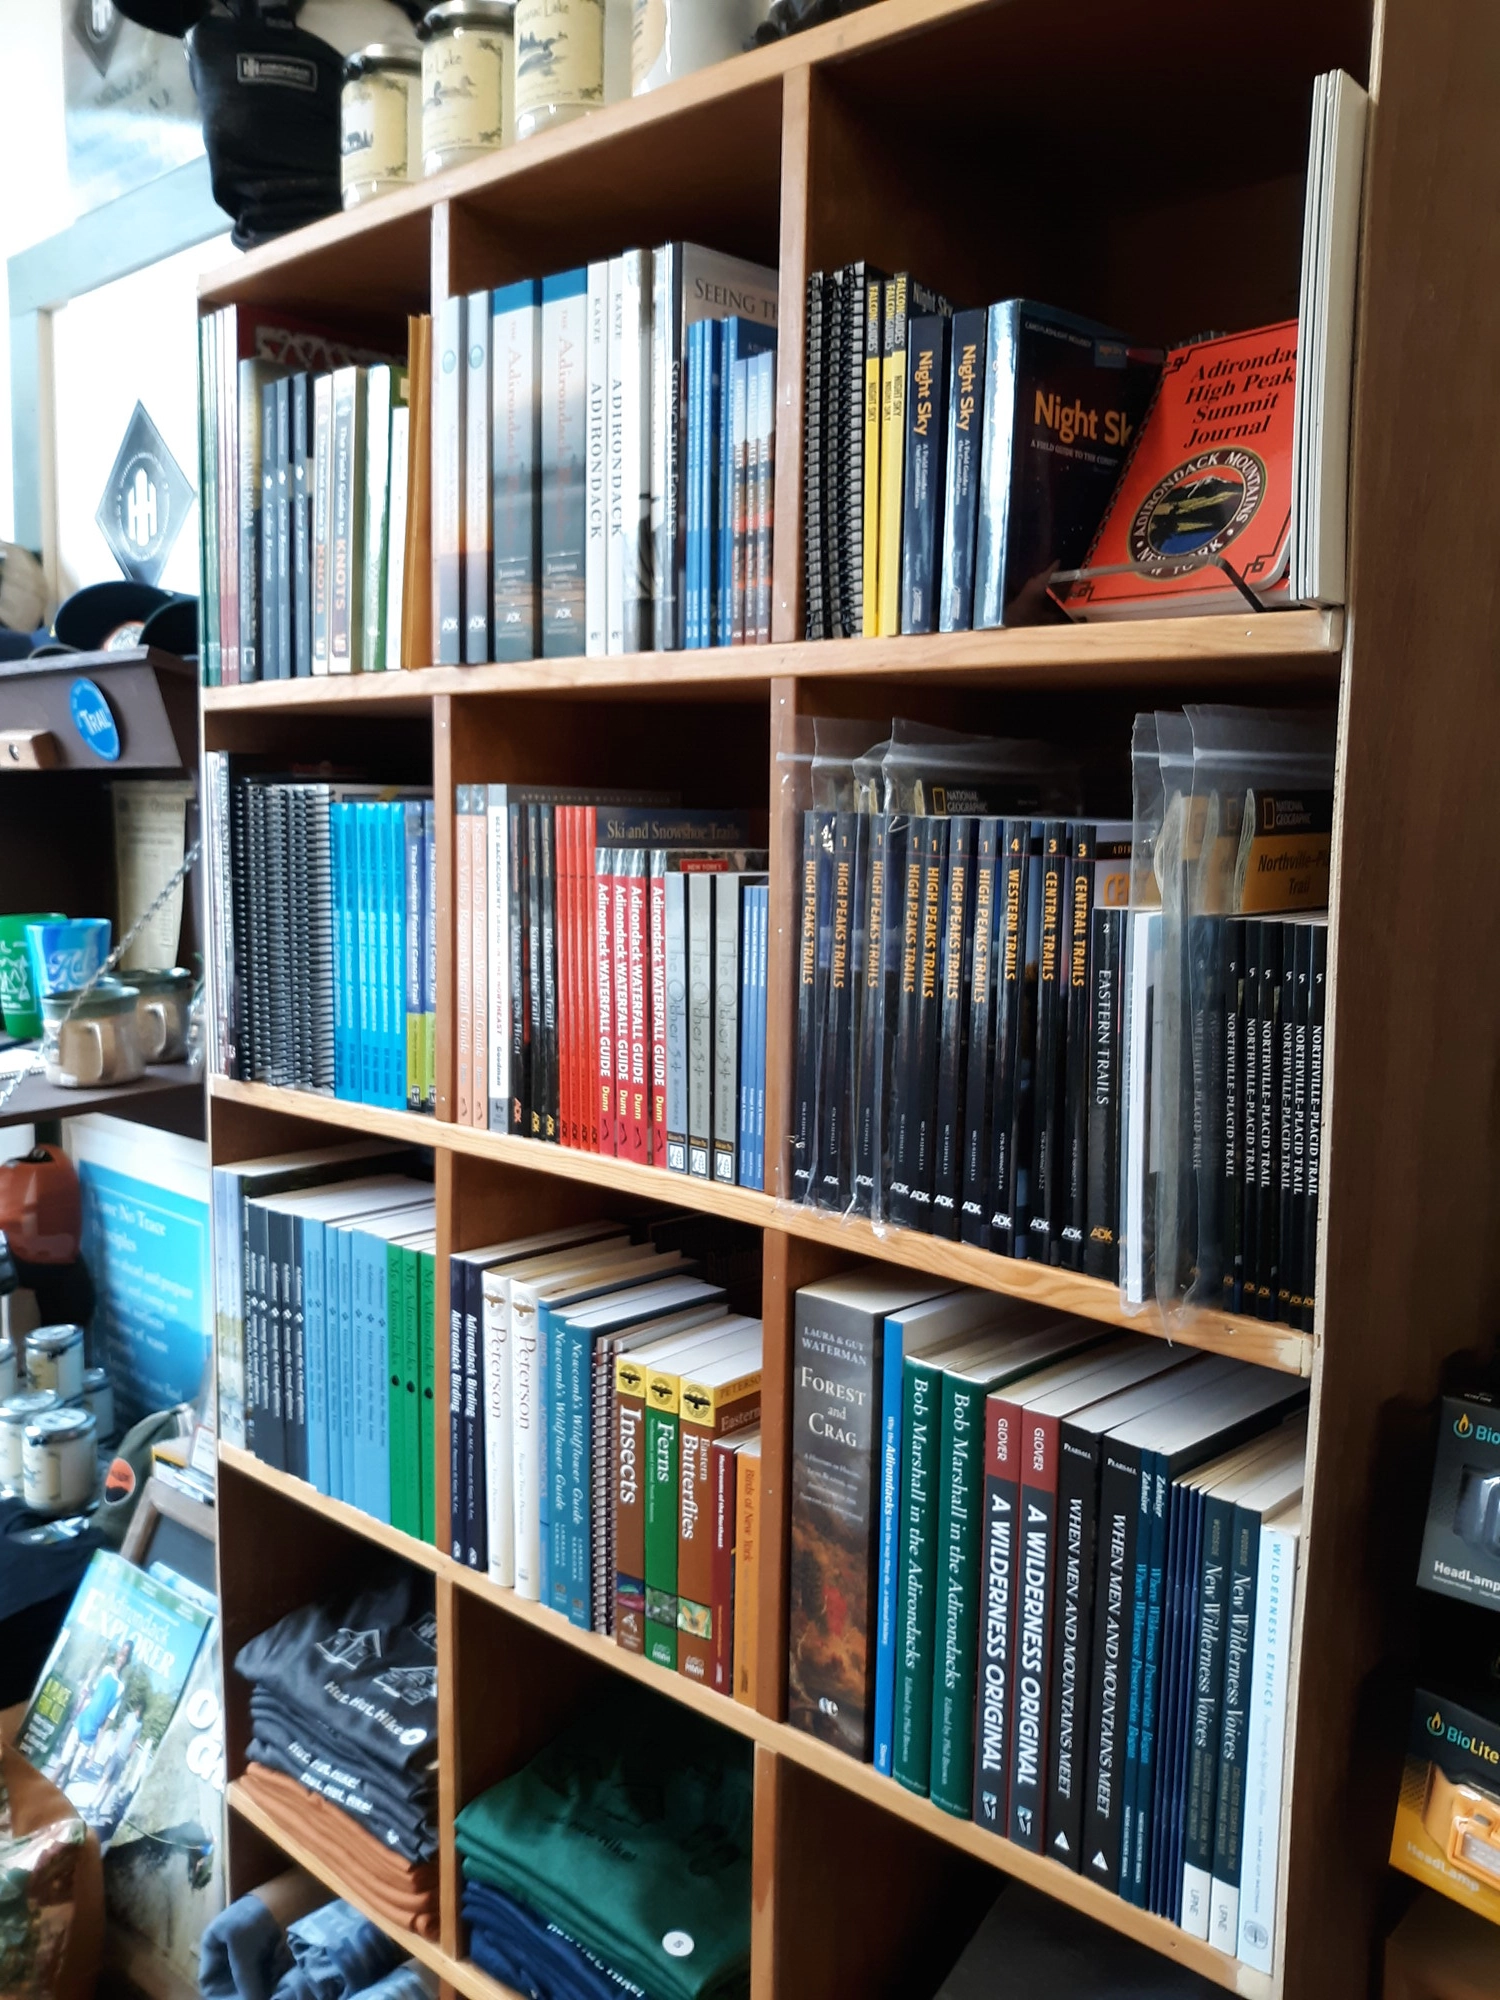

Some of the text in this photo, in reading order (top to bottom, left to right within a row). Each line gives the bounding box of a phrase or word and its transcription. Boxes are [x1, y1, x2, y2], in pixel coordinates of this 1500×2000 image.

[694, 277, 756, 315] SEEING
[913, 350, 934, 400] Night
[957, 344, 977, 395] Night
[1184, 366, 1295, 406] High Peak
[1190, 346, 1298, 384] Adirondac
[1192, 391, 1280, 425] Summit
[913, 400, 933, 437] Sky
[956, 396, 976, 432] Sky
[1033, 389, 1134, 448] Night Sk
[1182, 414, 1272, 449] Journal
[590, 382, 603, 538] ADIRONDACK
[611, 378, 623, 537] ADIRONDACK
[1133, 451, 1262, 537] ADIRONDACK MOUNTAINS
[606, 819, 627, 839] Ski
[626, 821, 648, 839] and
[802, 861, 816, 985] HIGH PEAKS TRAILS
[833, 862, 849, 989] HIGH PEAKS TRAILS
[867, 861, 883, 989] HIGH PEAKS TRAILS
[902, 864, 921, 993] HIGH PEAKS TRAILS
[922, 867, 939, 998] HIGH PEAKS TRAILS
[947, 867, 964, 1000] HIGH PEAKS TRAILS
[973, 869, 990, 1004] HIGH PEAKS TRAILS
[1003, 868, 1020, 981] WESTERN TRAILS
[1042, 871, 1058, 981] CENTRAL TRAILS
[1072, 876, 1088, 987] CENTRAL TRAILS
[598, 883, 611, 1112] Adirondack WATERFALL GUIDE Dunn
[614, 884, 628, 1115] Adirondack WATERFALL GUIDE Dunn
[631, 885, 644, 1120] Adirondack WATERFALL GUIDE Dunn
[653, 886, 665, 1122] Adirondack WATERFALL GUIDE Dunn
[1096, 969, 1112, 1106] EASTERN TRAILS
[1225, 1141, 1236, 1177] TRAIL
[1245, 1147, 1256, 1184] TRAIL
[1260, 1151, 1271, 1187] TRAIL
[1281, 1153, 1291, 1190] TRAIL
[1293, 1157, 1304, 1195] TRAIL
[1307, 1159, 1319, 1196] TRAIL
[449, 1309, 462, 1413] Adirondack Birding
[464, 1313, 478, 1418] Adirondack Birding
[490, 1326, 508, 1419] Peterson
[801, 1336, 867, 1367] WATERMAN
[803, 1325, 836, 1343] LAURA
[517, 1334, 537, 1430] Peterson
[553, 1327, 567, 1510] Newcomb's Wildflower Guide
[719, 1373, 762, 1399] PETERSO
[800, 1365, 867, 1406] FOREST
[826, 1404, 848, 1421] and
[619, 1404, 643, 1505] Insects
[655, 1421, 675, 1483] Ferns
[699, 1437, 711, 1481] Eastern
[807, 1411, 858, 1448] CRAG
[995, 1417, 1009, 1462] GLOVER
[1032, 1427, 1046, 1472] GLOVER
[681, 1432, 700, 1541] Butterflies
[742, 1511, 755, 1536] New
[743, 1468, 756, 1498] Birds
[904, 1378, 929, 1669] Bob Marshall in the Adirondacks
[742, 1538, 755, 1562] York
[944, 1391, 971, 1689] Bob Marshall in the Adirondacks
[982, 1493, 1011, 1771] A WILDERNESS ORIGINAL
[1017, 1503, 1048, 1786] A WILDERNESS ORIGINAL
[1057, 1497, 1083, 1799] WHEN MEN AND MOUNTAINS MEET
[1096, 1513, 1127, 1819] WHEN MEN AND MOUNTAINS MEET
[1194, 1561, 1224, 1748] New Wilderness Voices
[1223, 1570, 1253, 1760] New Wilderness Voices
[1446, 1725, 1500, 1765] BioLite
[1406, 1840, 1481, 1893] HeadLamp
